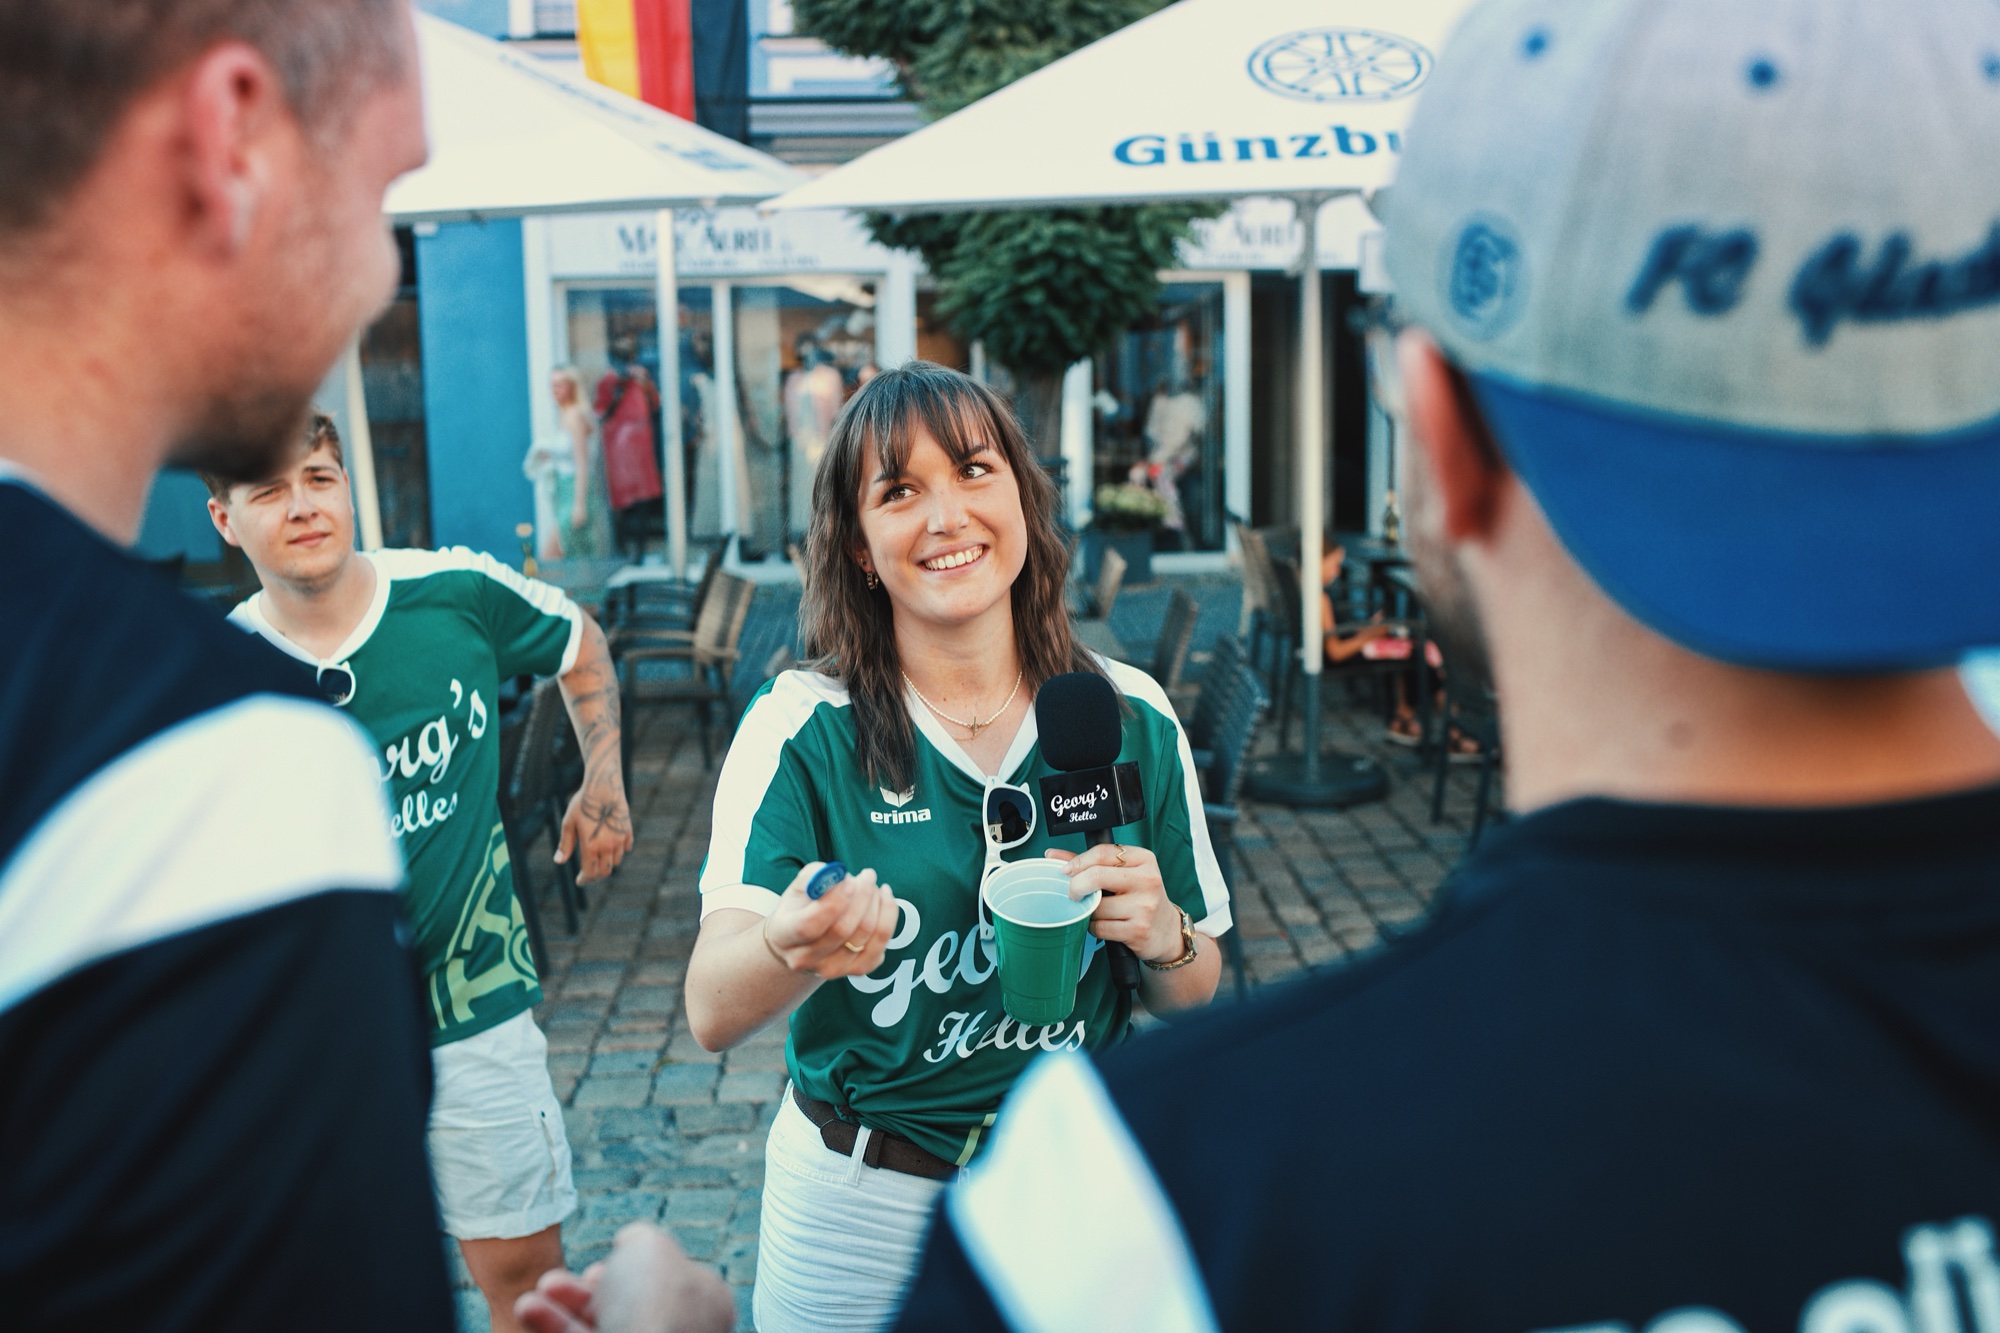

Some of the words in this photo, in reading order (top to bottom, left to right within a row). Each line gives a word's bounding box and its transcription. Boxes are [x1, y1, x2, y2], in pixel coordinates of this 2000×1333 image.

[369, 678, 487, 785] rg's
[386, 790, 459, 838] elles
[870, 808, 932, 825] erima
[1050, 784, 1109, 817] Georg's
[1069, 810, 1098, 823] Helles
[923, 1010, 1086, 1063] Helles
